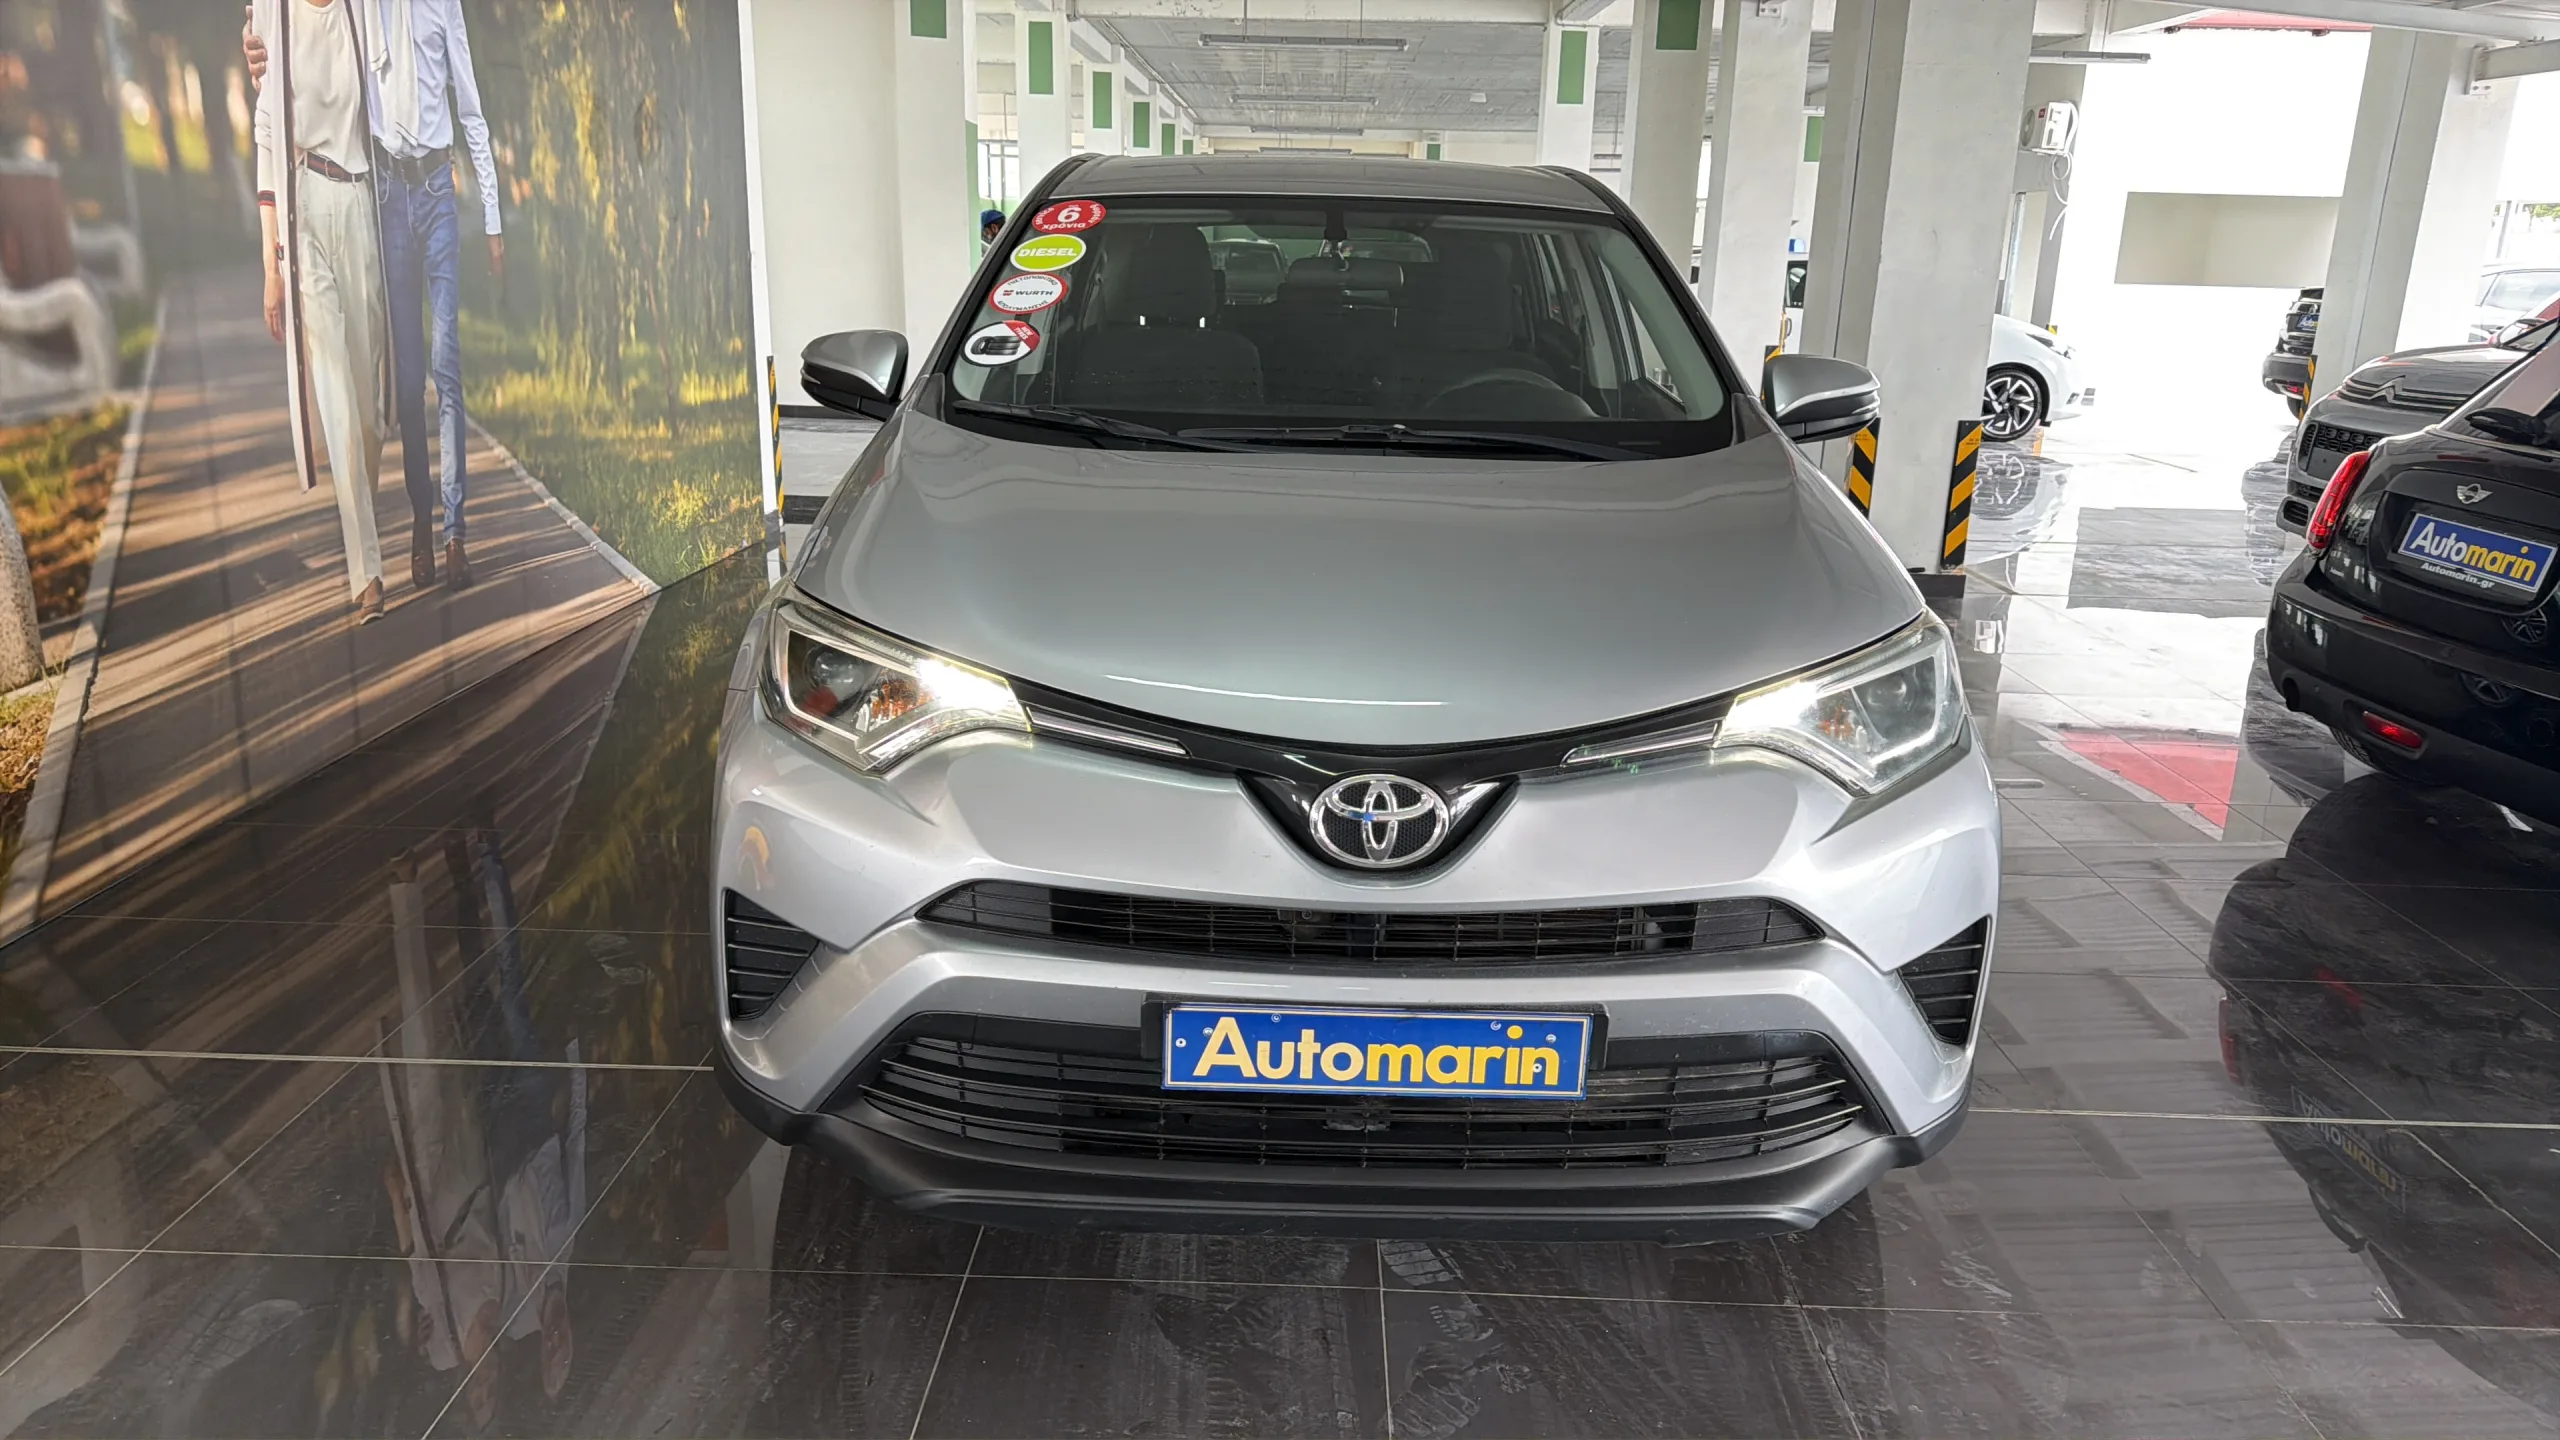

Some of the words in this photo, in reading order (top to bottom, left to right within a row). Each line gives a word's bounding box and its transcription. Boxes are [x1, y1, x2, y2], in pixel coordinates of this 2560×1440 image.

[1057, 207, 1082, 222] 6
[1042, 222, 1086, 230] χρόνια
[1018, 248, 1077, 257] DIESEL
[2409, 521, 2537, 582] Automarin
[2420, 562, 2495, 589] Automarin.gr
[1192, 1016, 1560, 1086] Automarin
